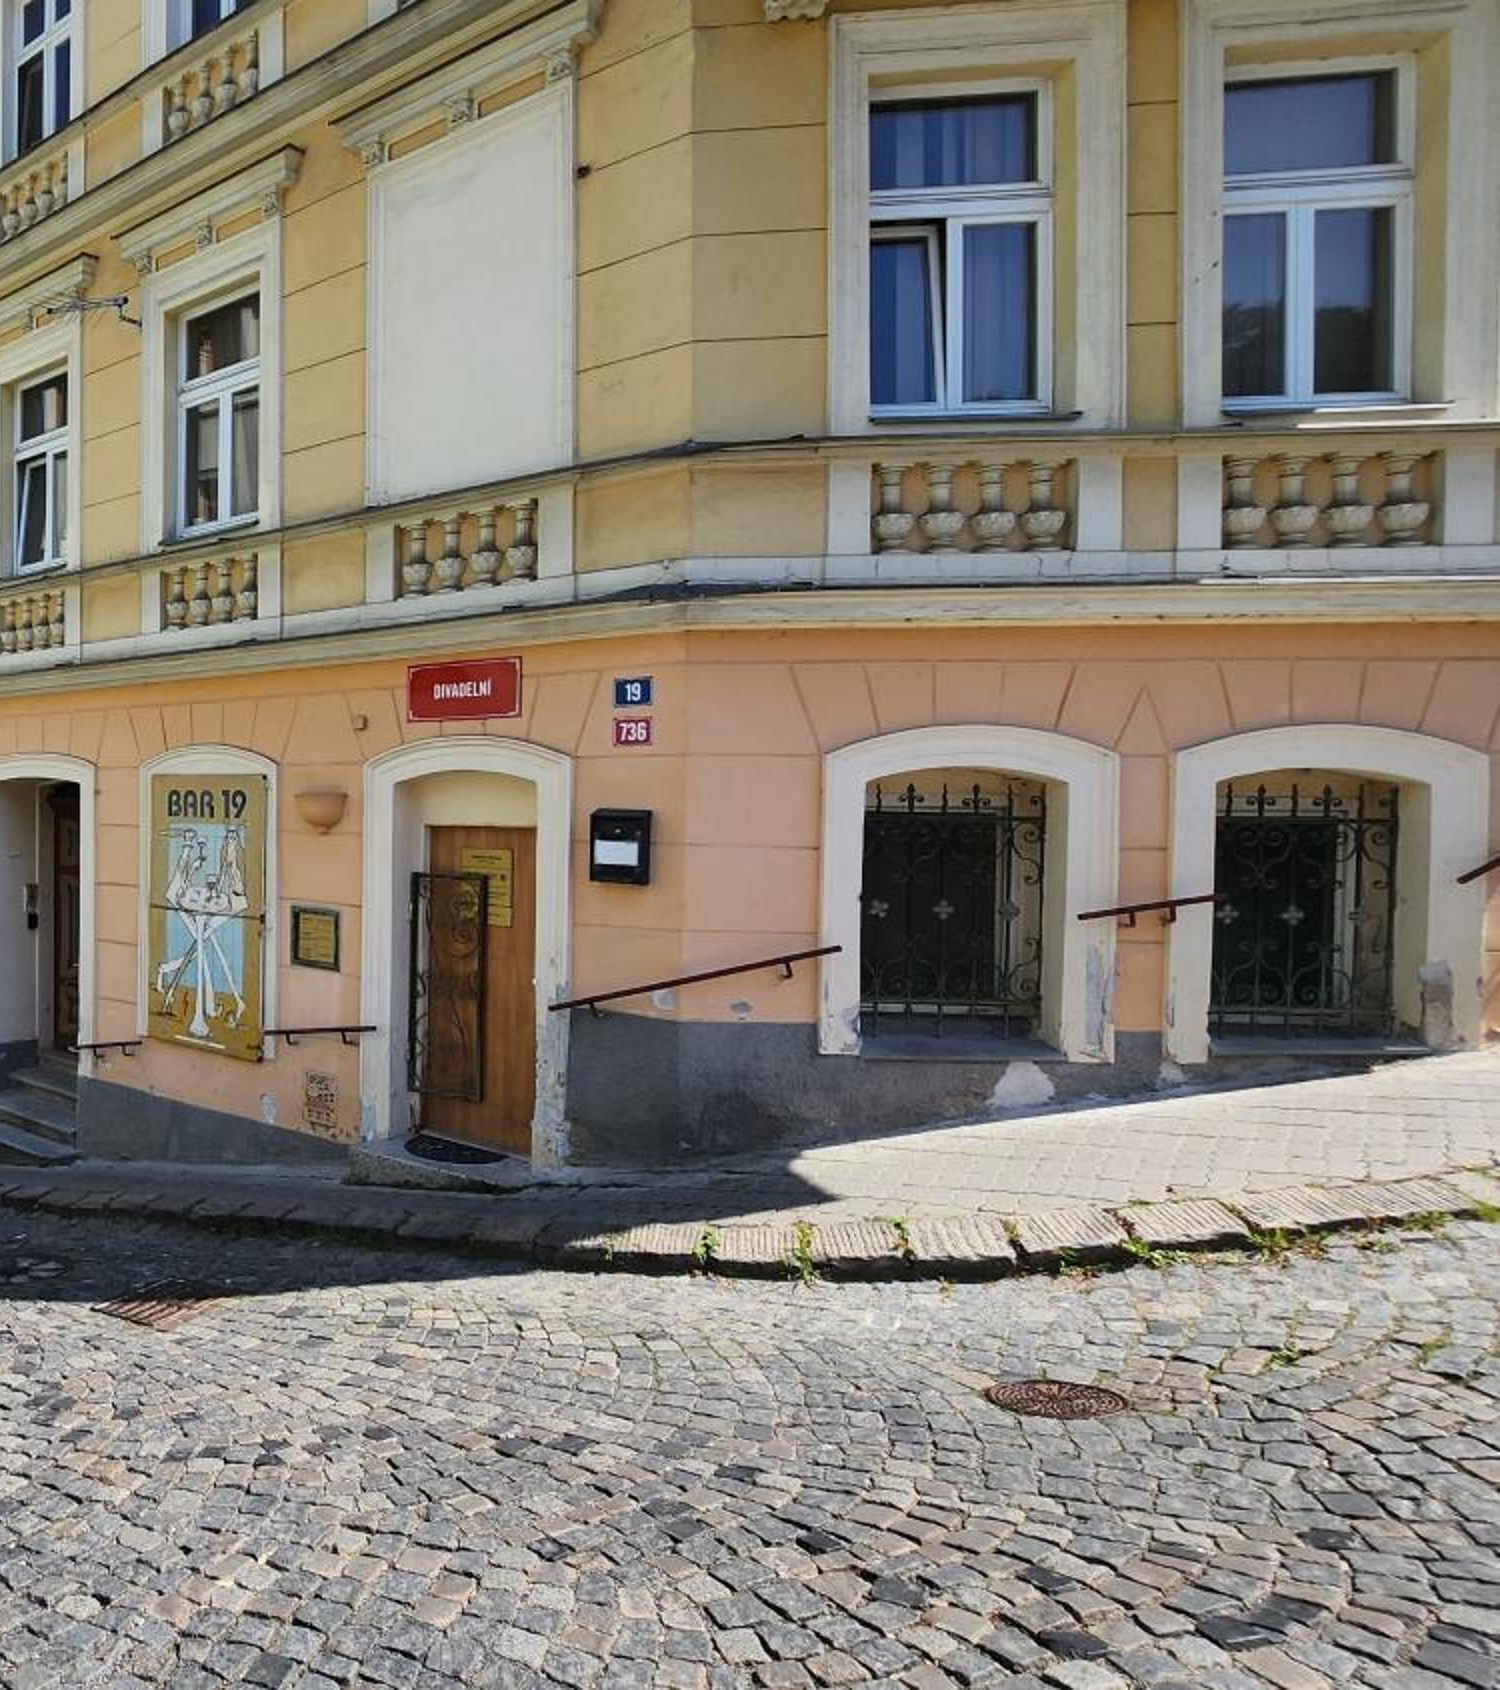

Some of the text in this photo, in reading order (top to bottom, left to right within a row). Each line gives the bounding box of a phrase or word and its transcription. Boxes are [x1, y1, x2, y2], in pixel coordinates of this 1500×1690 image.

[433, 677, 492, 700] DIVADELNÍ
[625, 682, 641, 702] 19
[619, 722, 647, 742] 736
[168, 789, 247, 819] BAR 19
